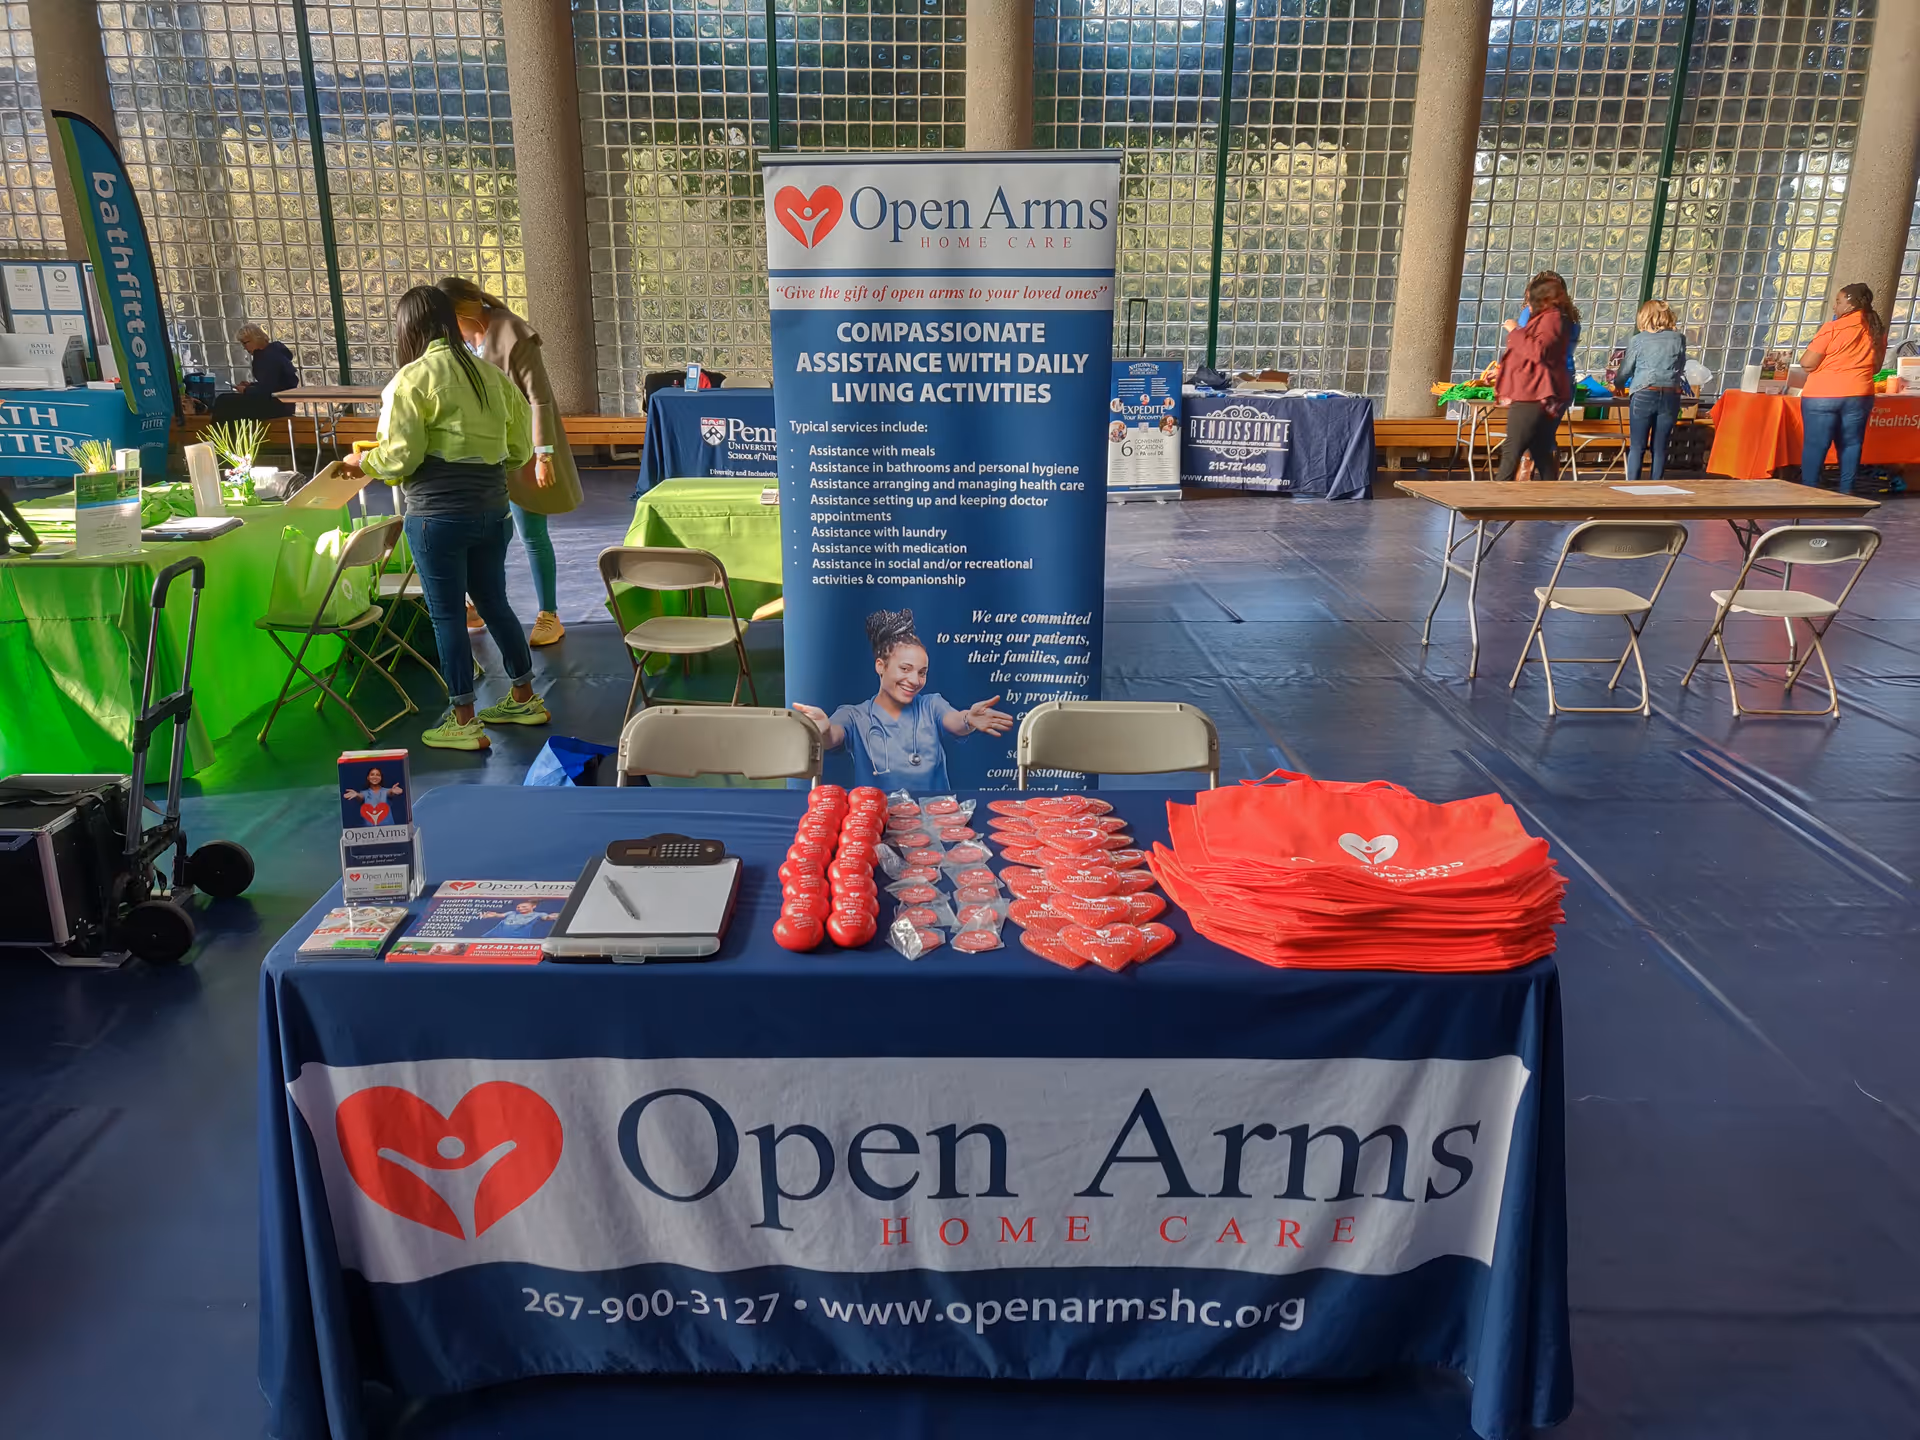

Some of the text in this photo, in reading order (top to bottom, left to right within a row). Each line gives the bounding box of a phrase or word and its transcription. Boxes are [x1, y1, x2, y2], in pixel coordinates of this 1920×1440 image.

[849, 185, 1108, 243] Open Arms
[921, 236, 1072, 249] HOME CARE
[819, 286, 840, 300] the
[844, 286, 869, 302] gift
[872, 286, 889, 302] of
[891, 288, 925, 302] open
[929, 288, 965, 300] arms
[969, 287, 983, 300] to
[987, 288, 1019, 302] your
[1023, 286, 1062, 300] loved
[836, 322, 1045, 343] COMPASSIONATE
[796, 353, 1089, 374] ASSISTANCE WITH DAILY
[831, 382, 1051, 403] LIVING ACTIVITIES
[789, 421, 928, 434] Typical services include:
[1190, 419, 1290, 443] RENAISSANCE
[809, 445, 935, 457] Assistance with meals
[1121, 439, 1134, 457] 6
[754, 452, 762, 462] of
[809, 462, 1079, 476] Assistance in bathrooms and personal hygiene
[810, 479, 1085, 492] Assistance arranging and managing health care
[810, 495, 1048, 508] Assistance setting up and keeping doctor
[810, 511, 892, 523] appointments
[811, 527, 947, 540] Assistance with laundry
[812, 542, 967, 554] Assistance with medication
[812, 558, 1033, 570] Assistance in social and/or recreational
[812, 574, 966, 588] activities & companionship
[971, 610, 1092, 625] We are committed
[936, 630, 1090, 647] to serving our patients,
[968, 650, 1090, 666] their families, and
[990, 670, 1089, 687] the community
[1006, 690, 1022, 704] by
[987, 767, 1086, 781] compssionate,
[345, 828, 406, 843] Open Arms
[478, 882, 575, 890] Open Arms
[313, 927, 389, 935] GRAND
[617, 1087, 1482, 1232] Open Arms
[880, 1215, 1356, 1249] HOME CARE
[521, 1286, 1306, 1333] 267-900-3127 www.openarmshc.org
